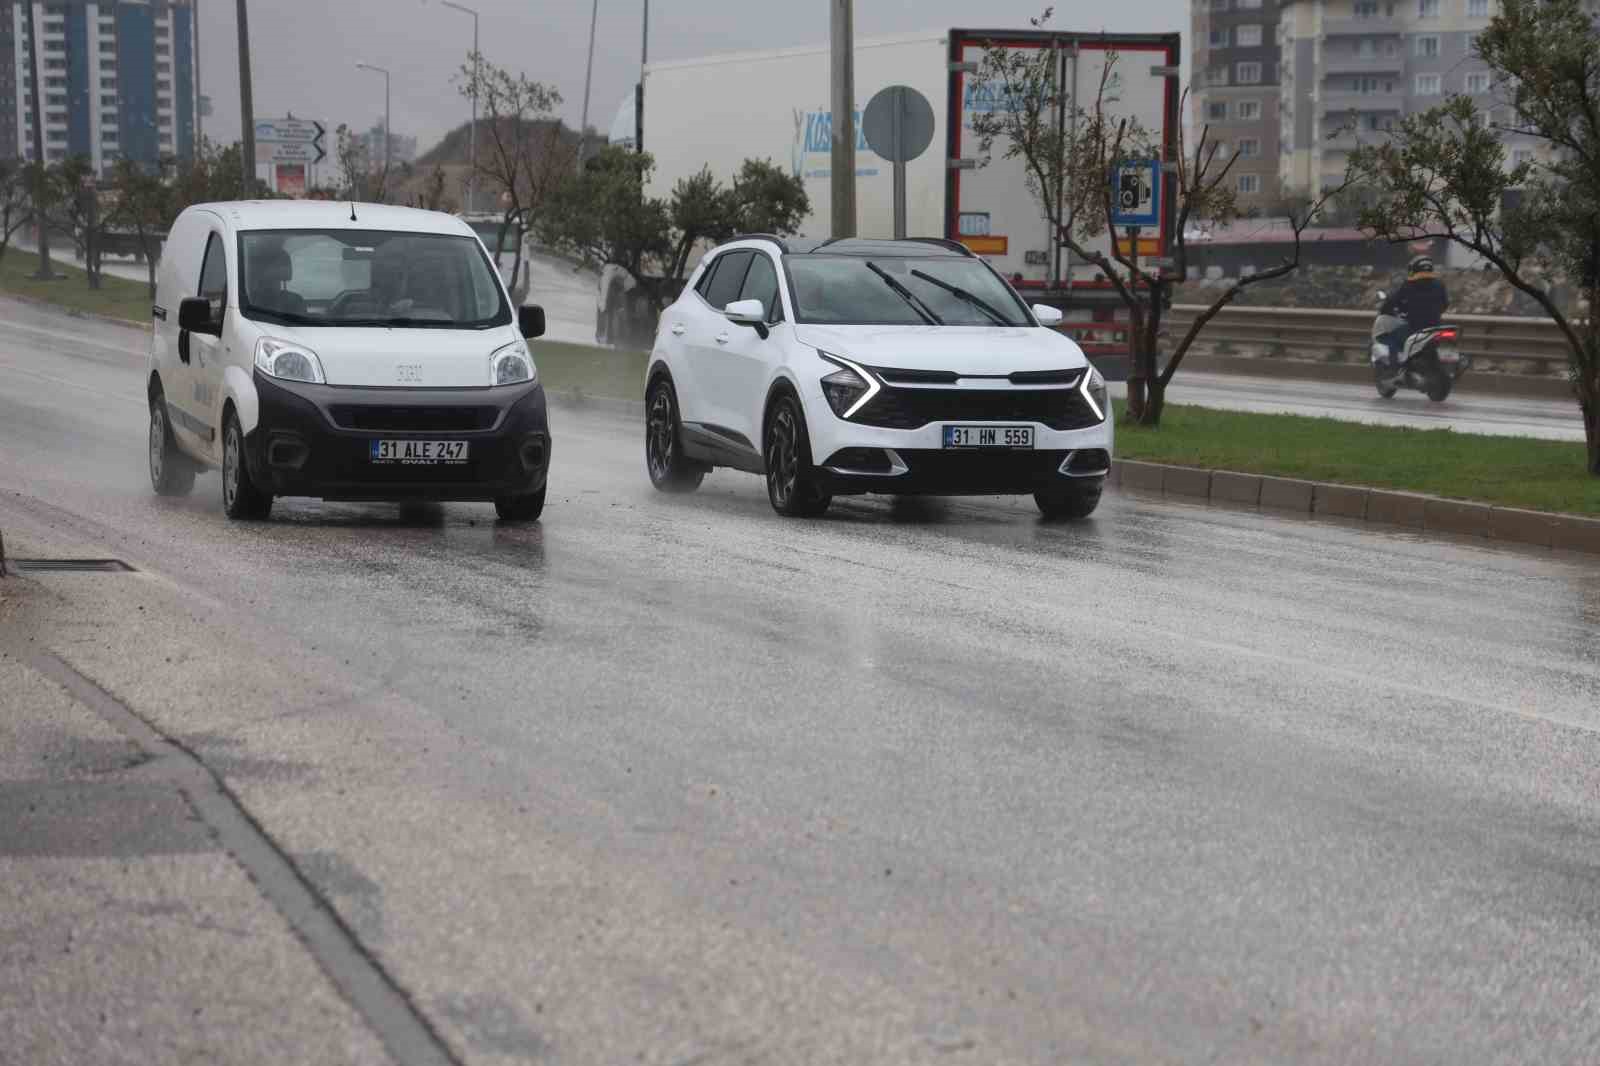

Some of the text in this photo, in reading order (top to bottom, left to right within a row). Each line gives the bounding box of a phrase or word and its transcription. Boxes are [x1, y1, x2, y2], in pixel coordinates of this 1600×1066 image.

[954, 428, 1029, 445] 31 HN 559
[380, 442, 397, 458] 31
[404, 442, 431, 458] ALE
[437, 442, 463, 459] 247
